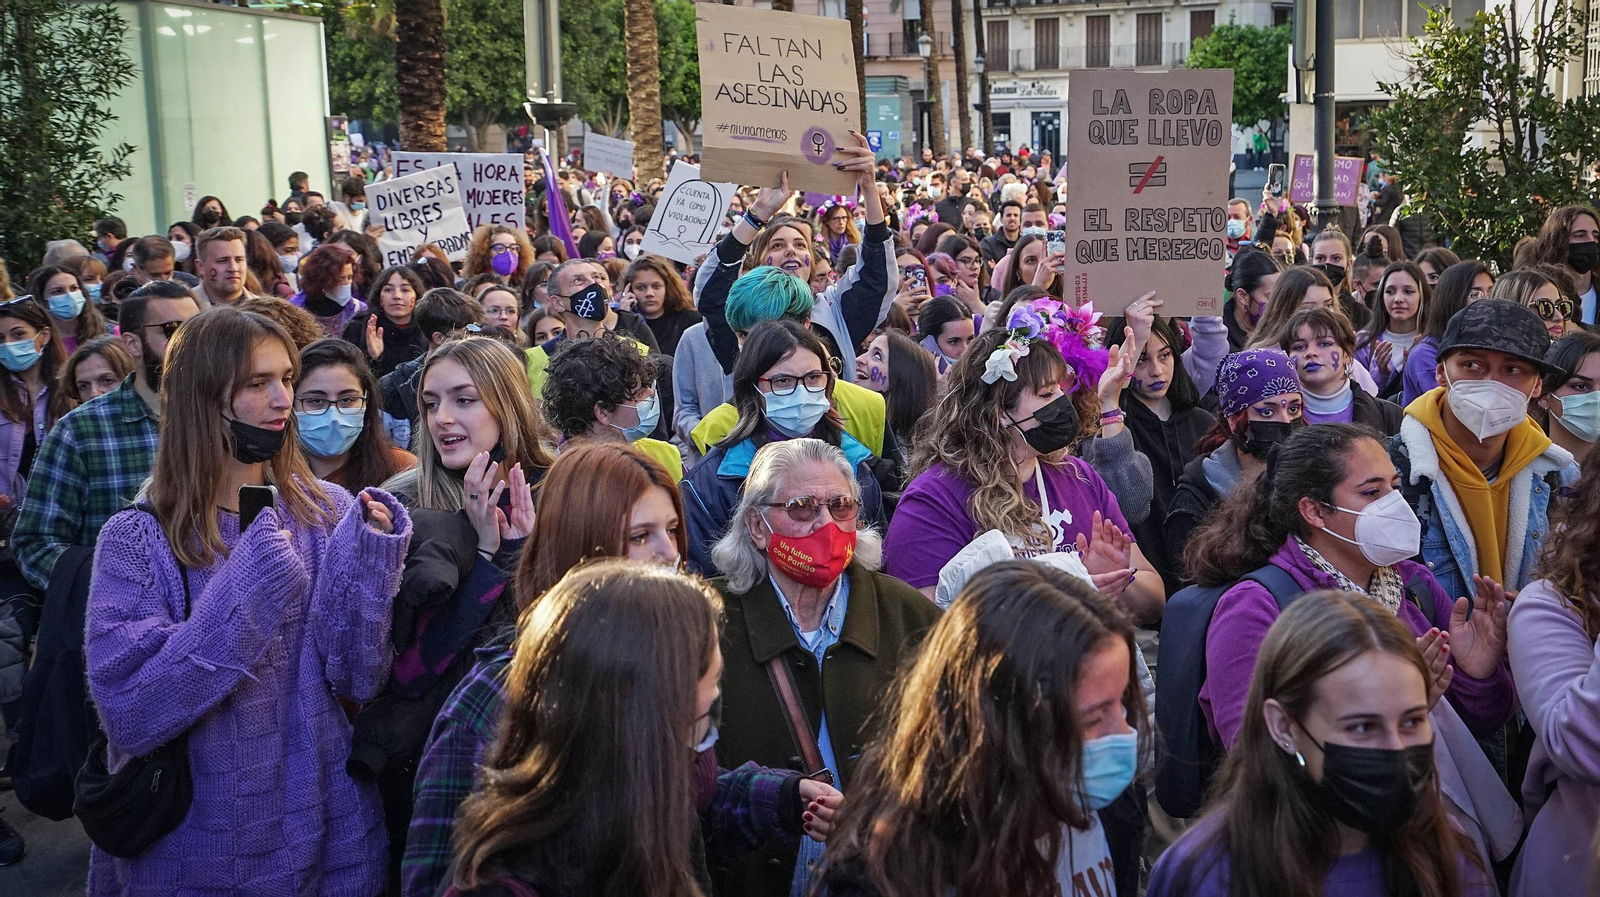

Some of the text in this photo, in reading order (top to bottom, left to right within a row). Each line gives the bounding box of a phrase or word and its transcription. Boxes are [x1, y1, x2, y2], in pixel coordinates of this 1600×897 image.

[723, 32, 822, 61] FALTAN
[758, 62, 804, 86] LAS
[715, 82, 848, 115] ASESINADAS
[1092, 88, 1219, 116] LA ROPA
[715, 121, 788, 141] #niunamenos
[1088, 118, 1223, 147] QUE LLEVO
[473, 162, 520, 183] HORA
[466, 188, 523, 209] MUJERES
[676, 197, 706, 212] YA COMO
[680, 185, 711, 201] ¿CUENTA
[1083, 206, 1227, 233] EL RESPETO
[417, 226, 428, 243] Y
[387, 231, 472, 267] EMPRADAS
[1075, 238, 1120, 264] QUE
[1125, 237, 1225, 262] MEREZCO
[773, 547, 816, 573] con Partido
[780, 541, 813, 563] Un futuro
